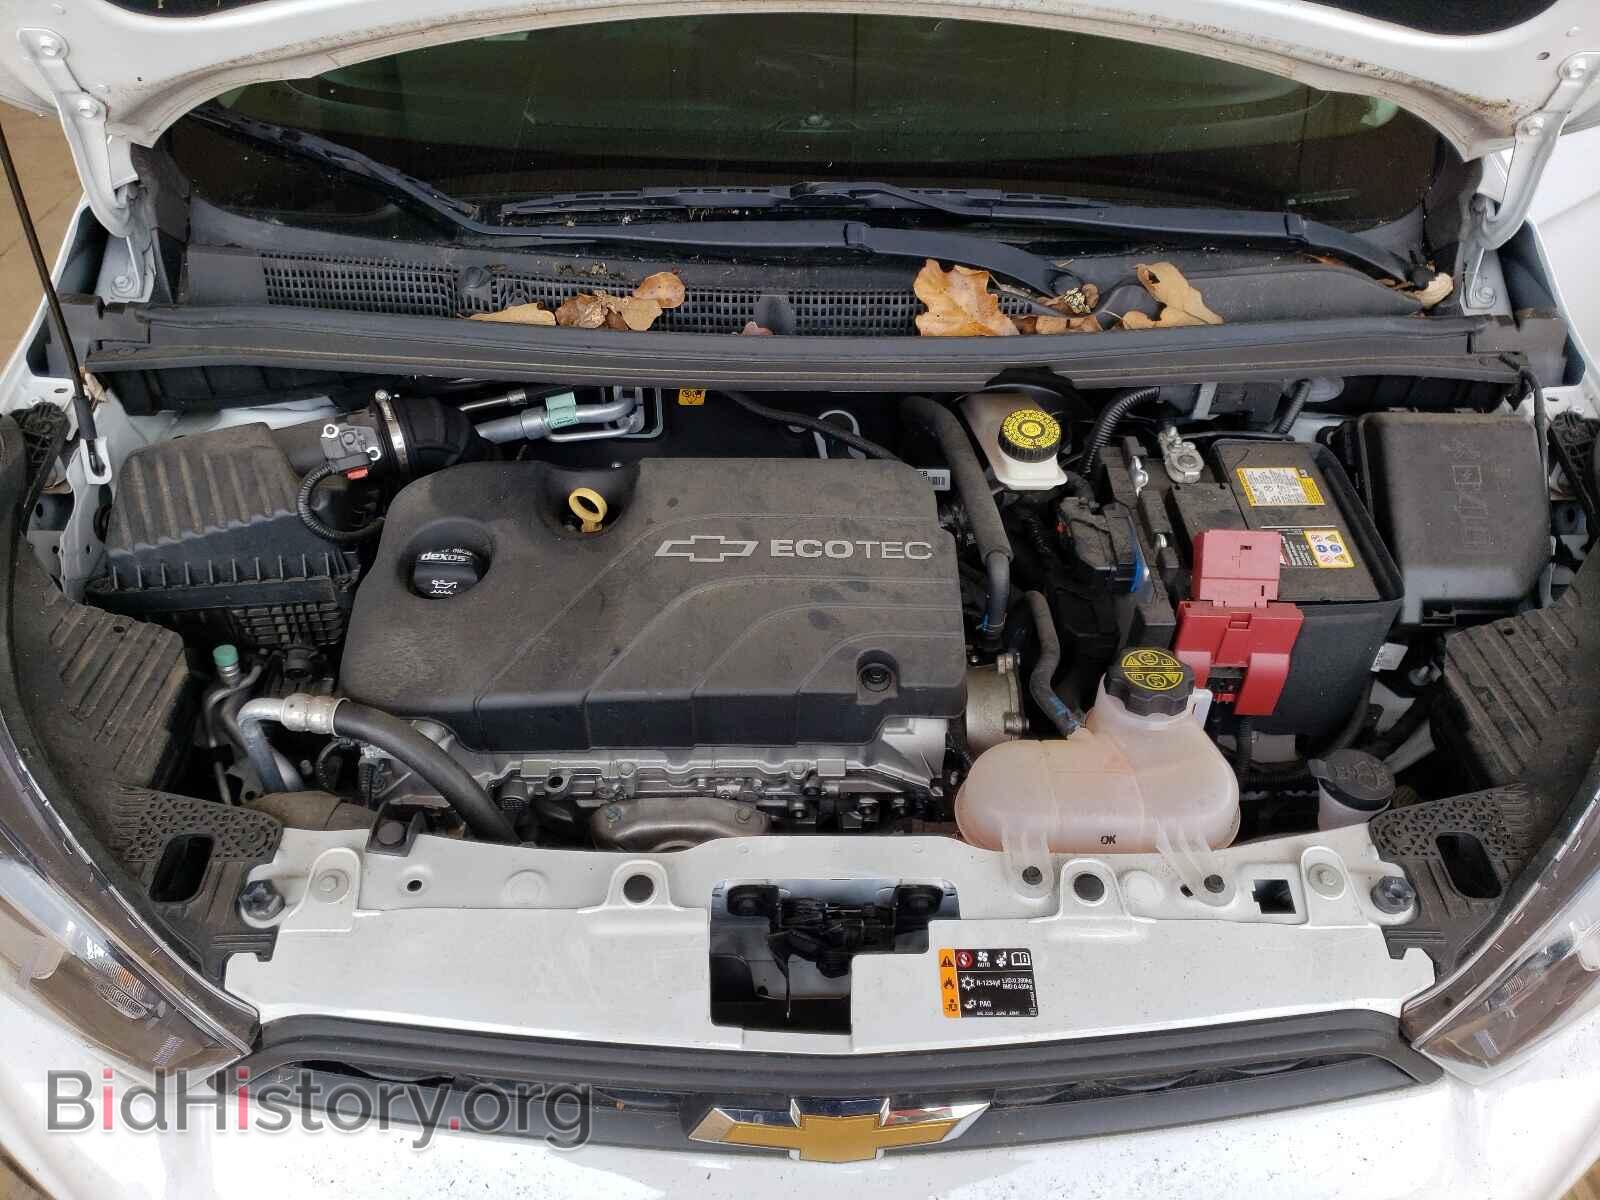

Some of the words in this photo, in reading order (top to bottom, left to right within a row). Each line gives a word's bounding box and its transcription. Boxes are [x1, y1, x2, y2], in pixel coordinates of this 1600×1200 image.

[770, 540, 933, 560] ECOTEC
[421, 552, 466, 561] dexos
[1100, 834, 1116, 845] OK
[979, 1000, 992, 1008] PAG
